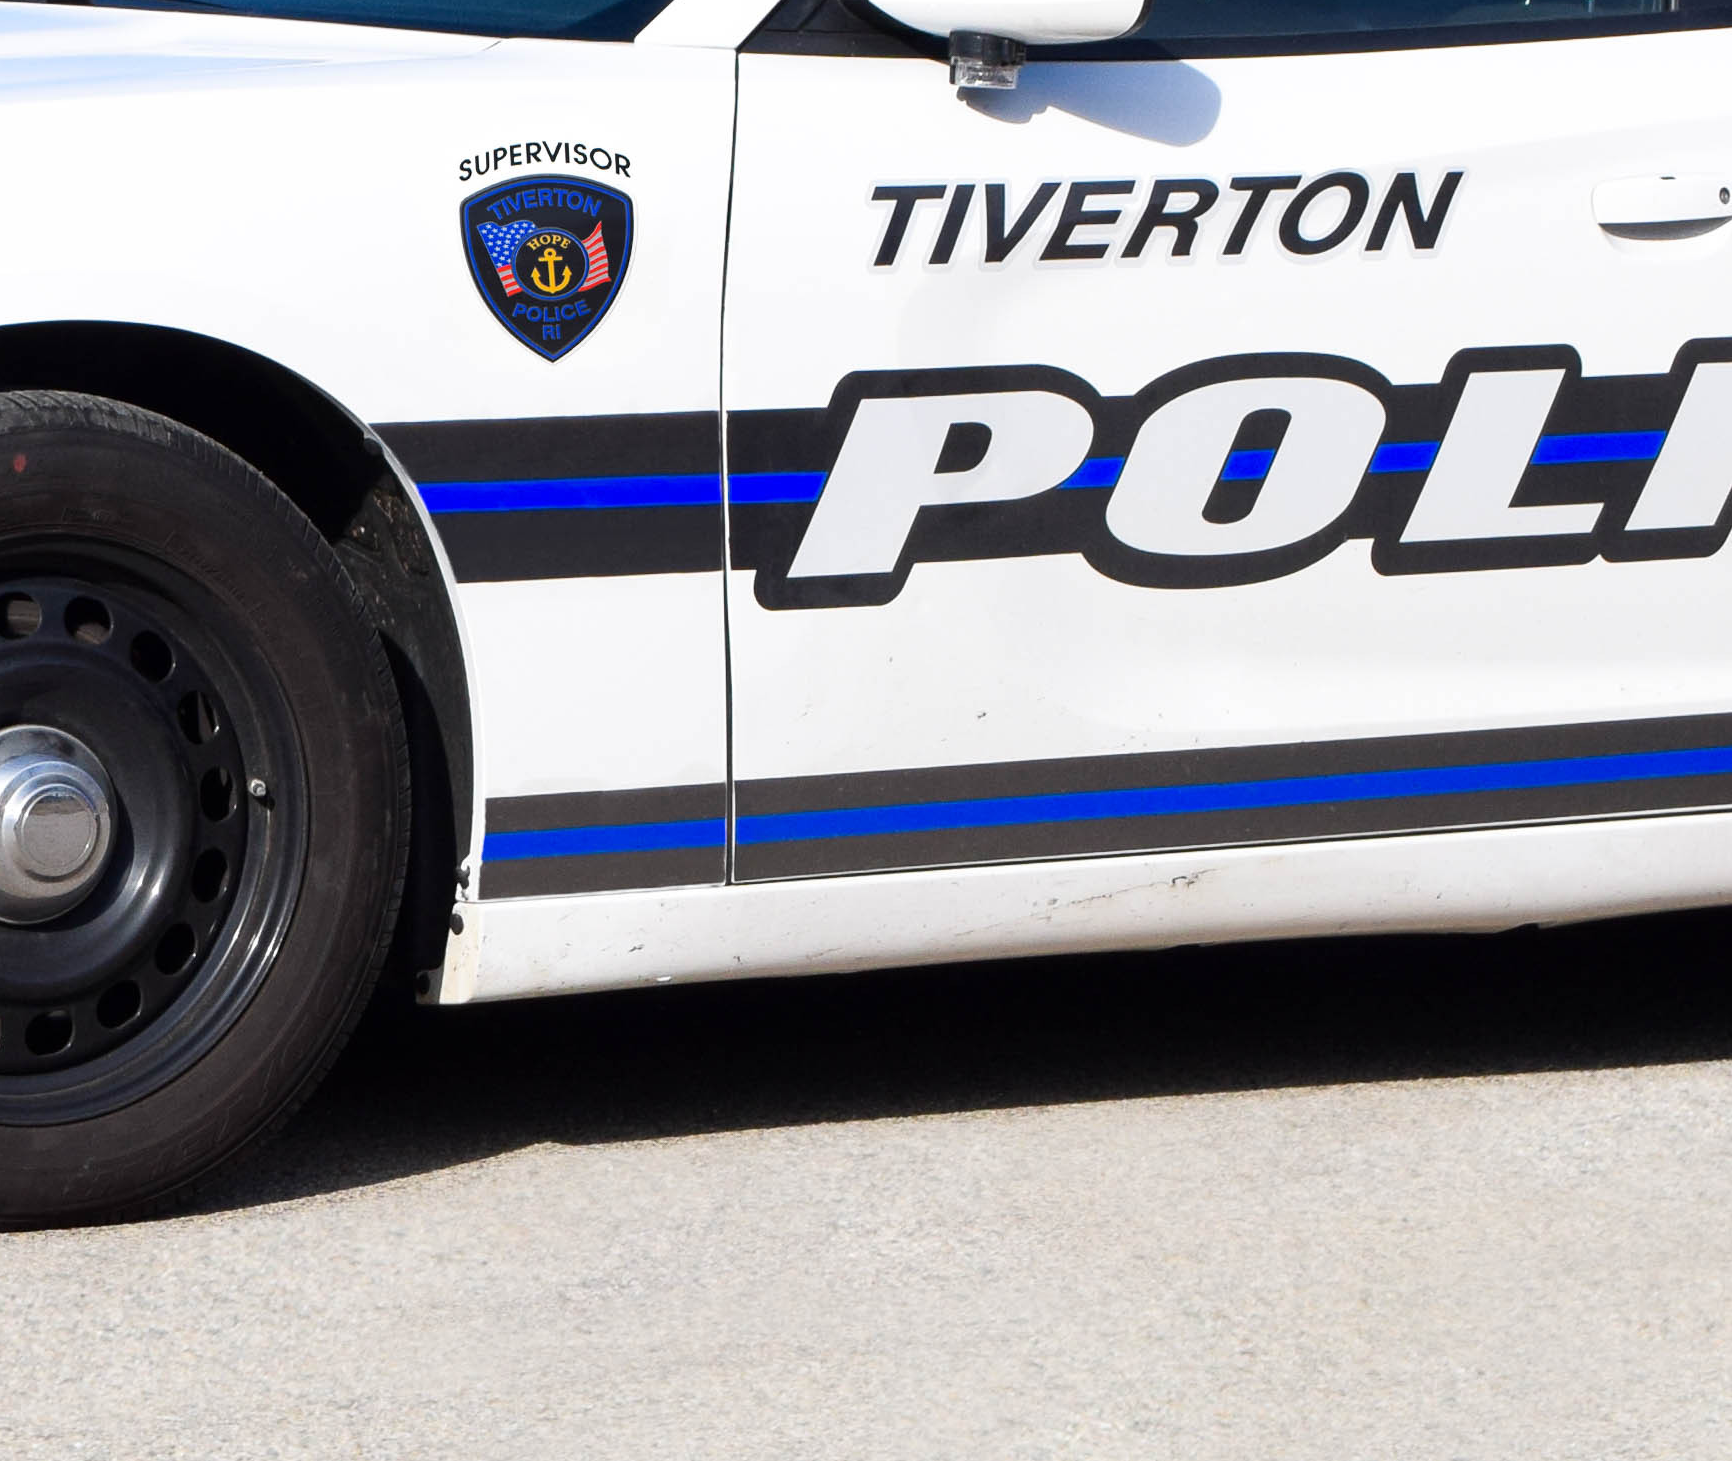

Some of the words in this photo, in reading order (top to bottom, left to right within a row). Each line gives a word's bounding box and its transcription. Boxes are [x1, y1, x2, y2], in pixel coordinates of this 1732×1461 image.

[459, 140, 631, 182] SUPERVISOR
[486, 187, 603, 221] TIVERTON
[871, 171, 1464, 267] TIVERTON
[527, 234, 571, 251] HOPE
[512, 299, 591, 323] POLICE
[542, 324, 562, 340] RI
